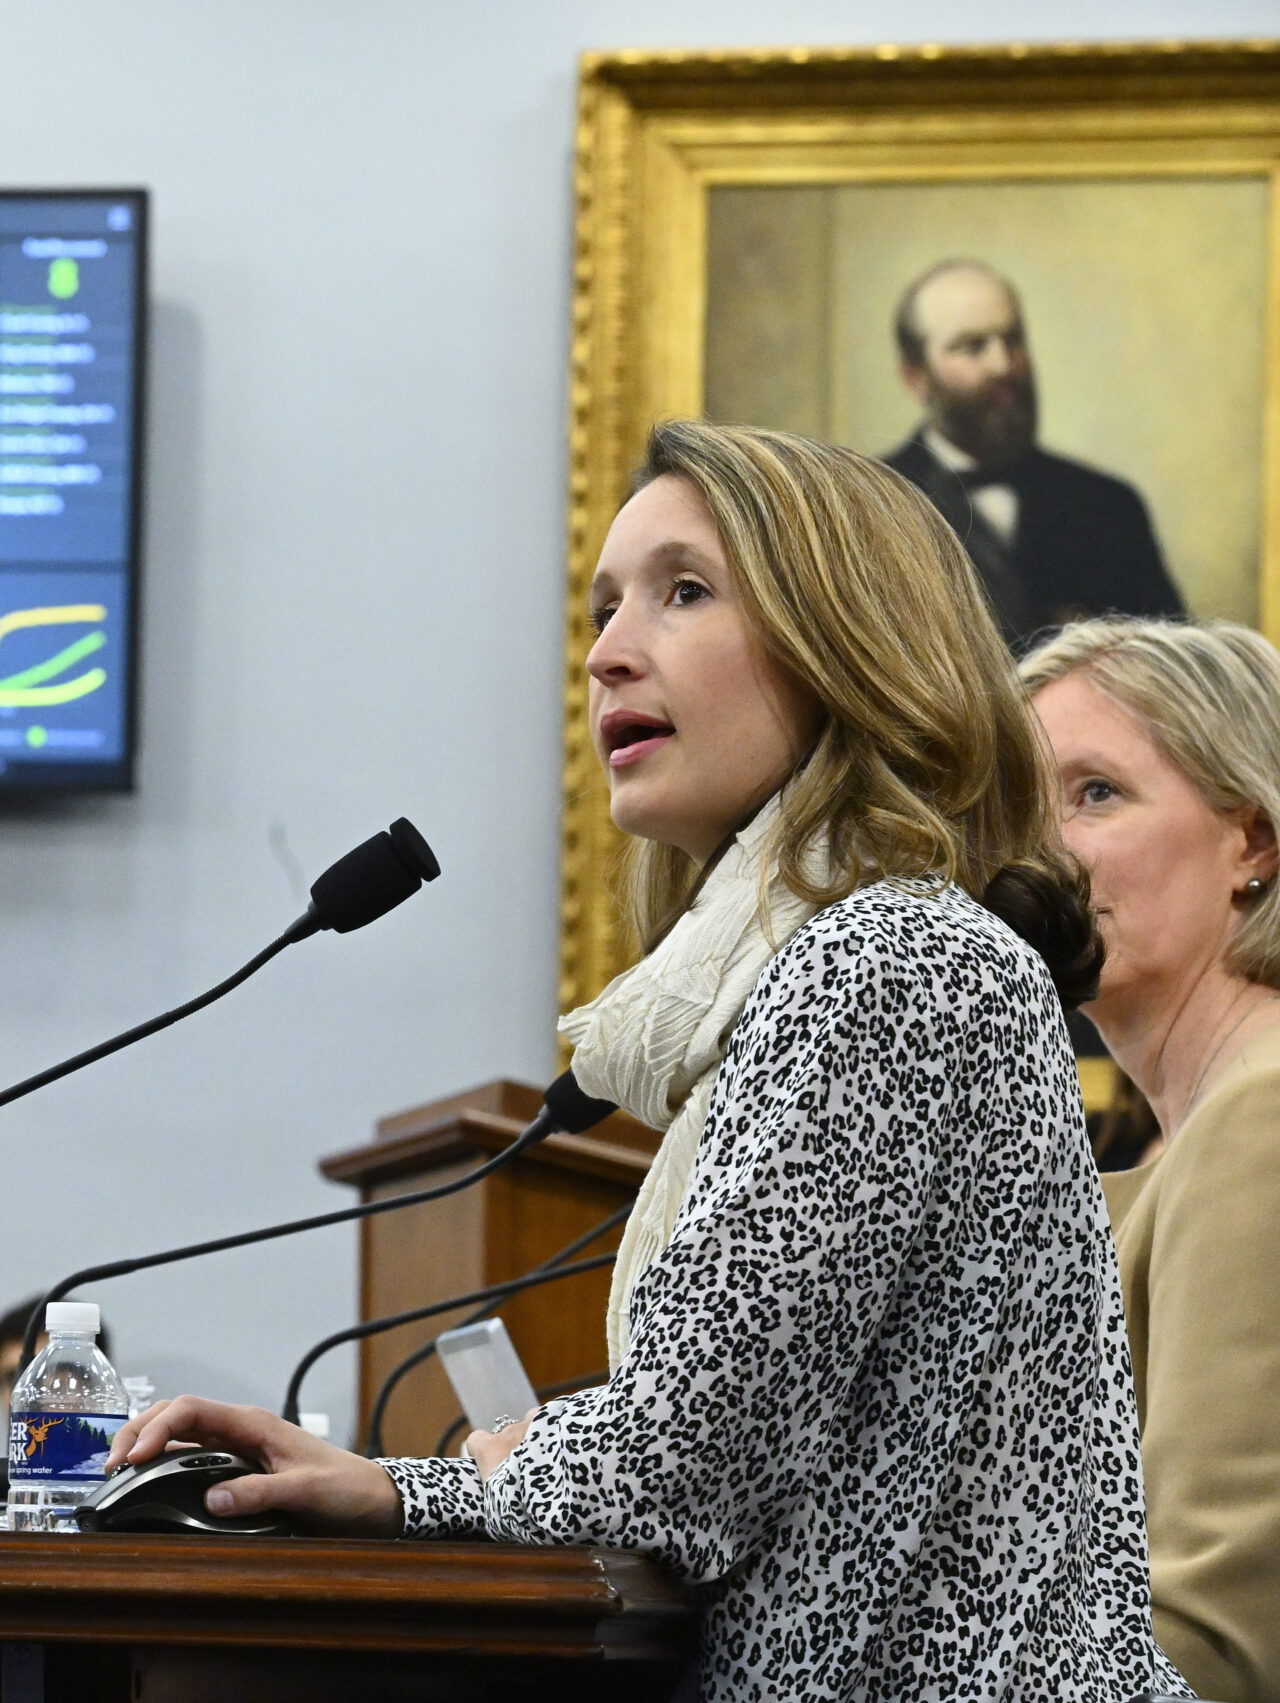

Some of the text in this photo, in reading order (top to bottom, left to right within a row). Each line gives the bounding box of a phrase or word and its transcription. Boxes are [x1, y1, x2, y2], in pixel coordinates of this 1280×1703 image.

[10, 1422, 27, 1440] ER
[9, 1442, 28, 1464] RK
[32, 1466, 53, 1474] water
